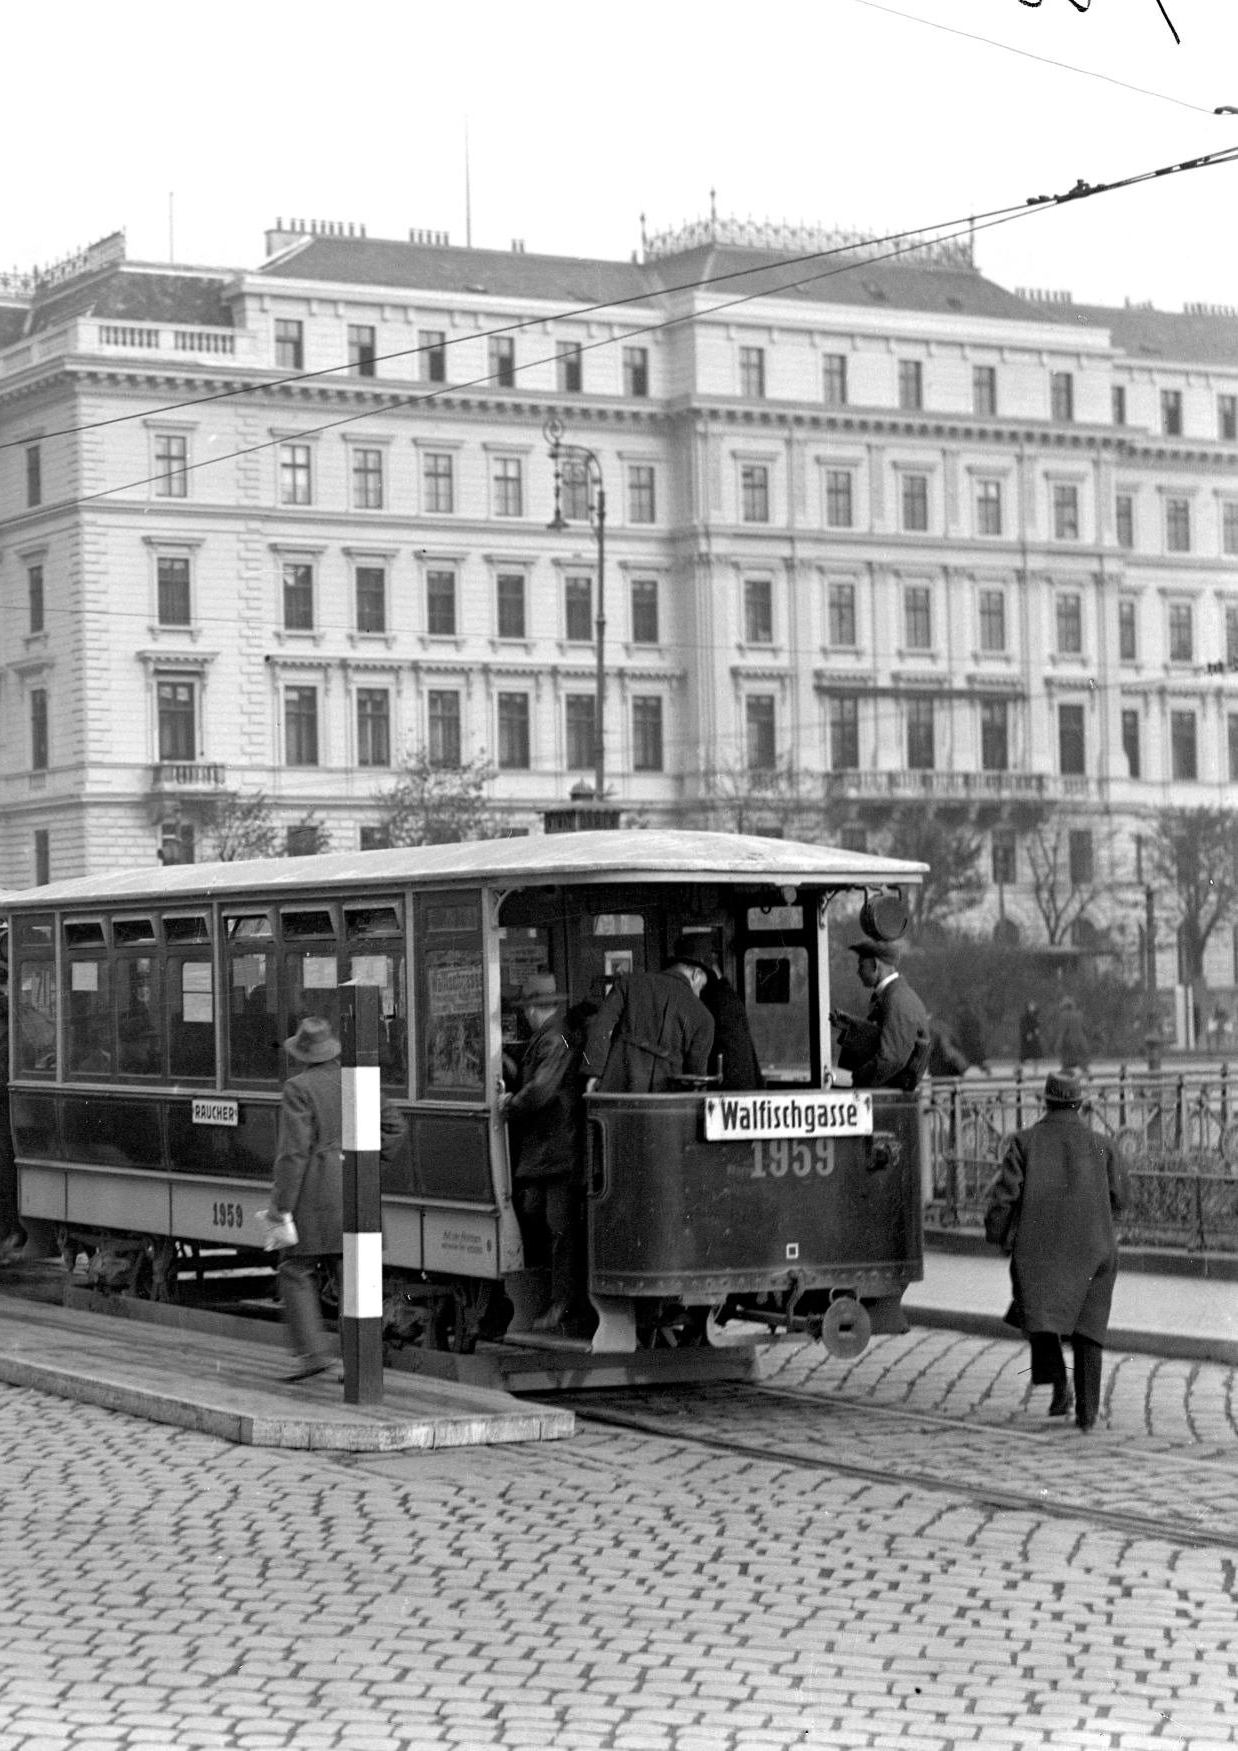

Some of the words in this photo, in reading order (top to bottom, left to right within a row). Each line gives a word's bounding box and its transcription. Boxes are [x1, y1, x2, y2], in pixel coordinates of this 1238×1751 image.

[195, 1104, 234, 1121] RAUCHER
[721, 1100, 857, 1133] Walfischgasse
[750, 1139, 834, 1178] 1959
[212, 1202, 243, 1228] 1959
